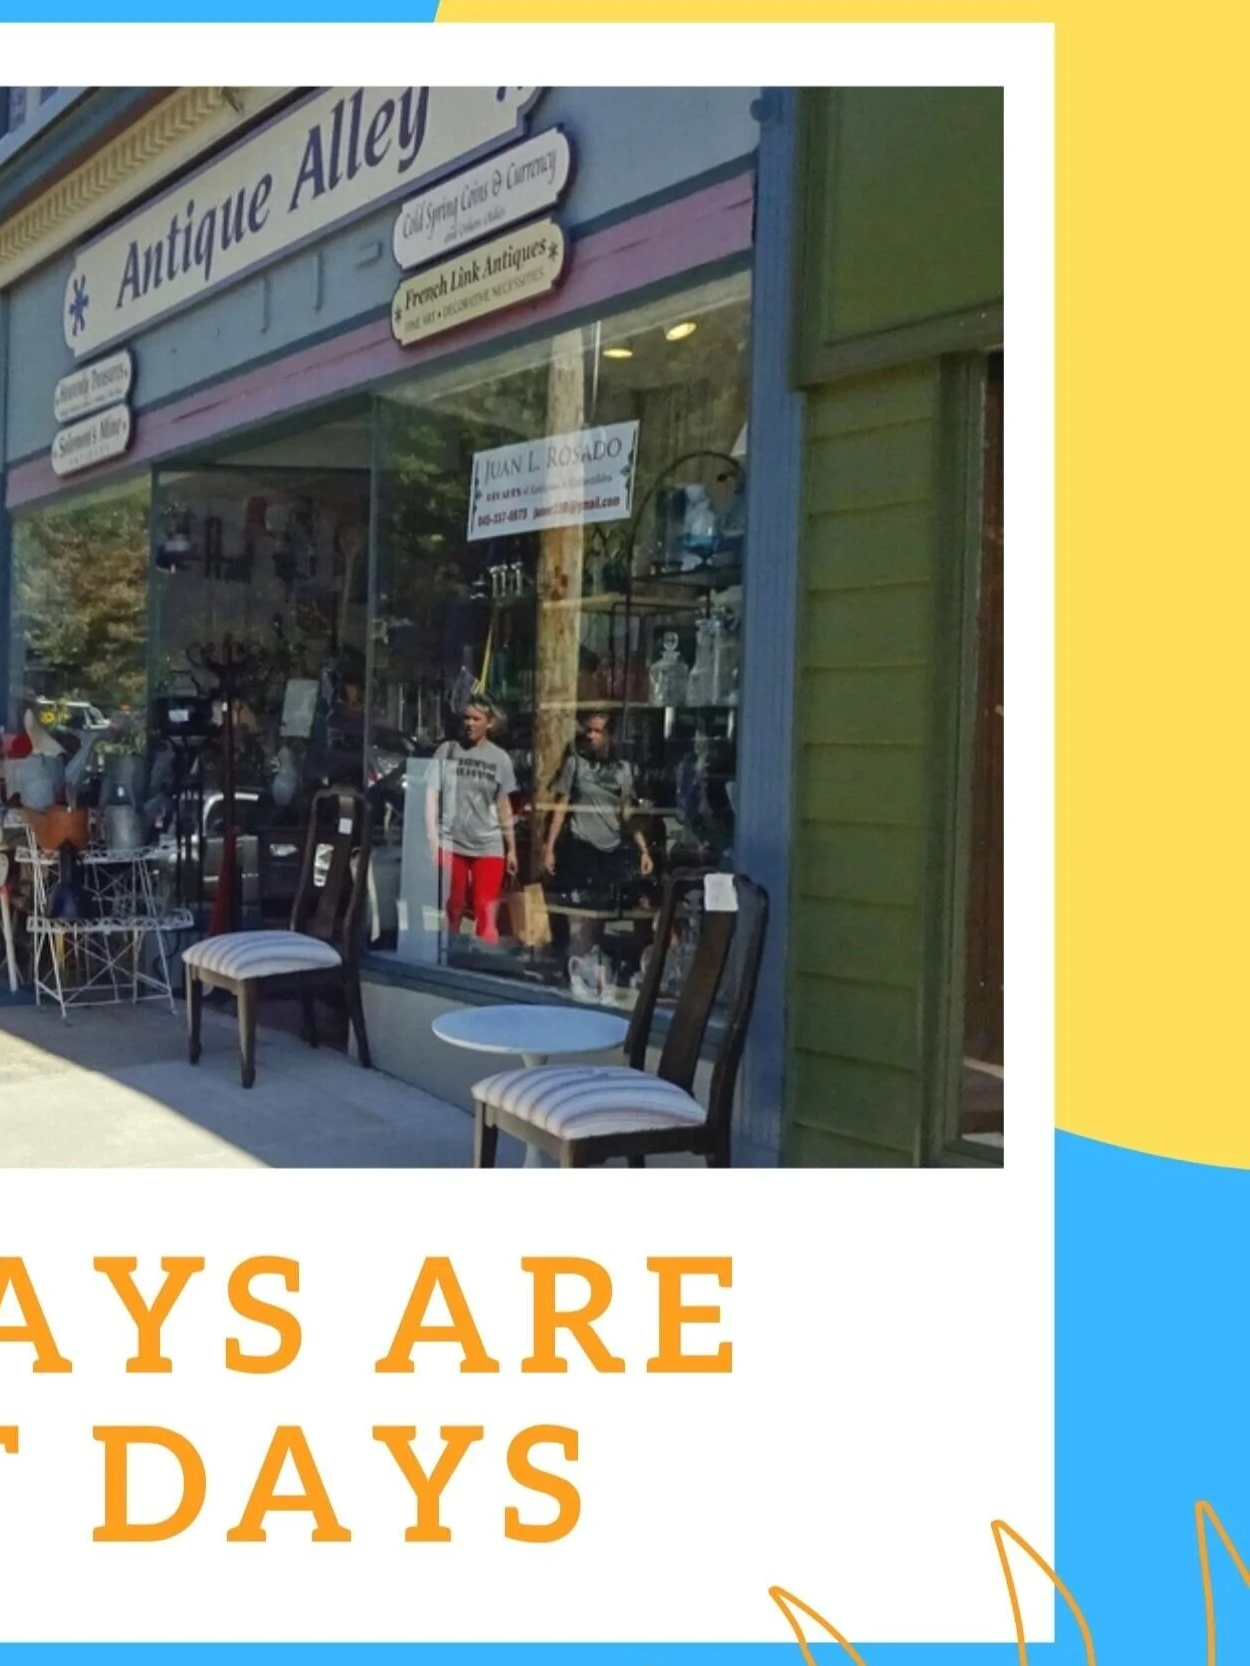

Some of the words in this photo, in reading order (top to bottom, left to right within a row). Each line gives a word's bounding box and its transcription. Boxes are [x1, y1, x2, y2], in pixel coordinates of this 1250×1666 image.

[116, 173, 273, 309] Antique
[287, 87, 430, 213] Alley
[402, 201, 424, 239] Cold
[425, 195, 458, 241] Spring
[461, 179, 489, 212] Coins
[492, 169, 502, 197] &
[506, 150, 557, 191] Currency
[405, 274, 448, 312] French
[450, 259, 480, 292] Link
[482, 238, 547, 281] Antiques
[484, 454, 523, 487] JUAN
[547, 436, 623, 469] ROSADO
